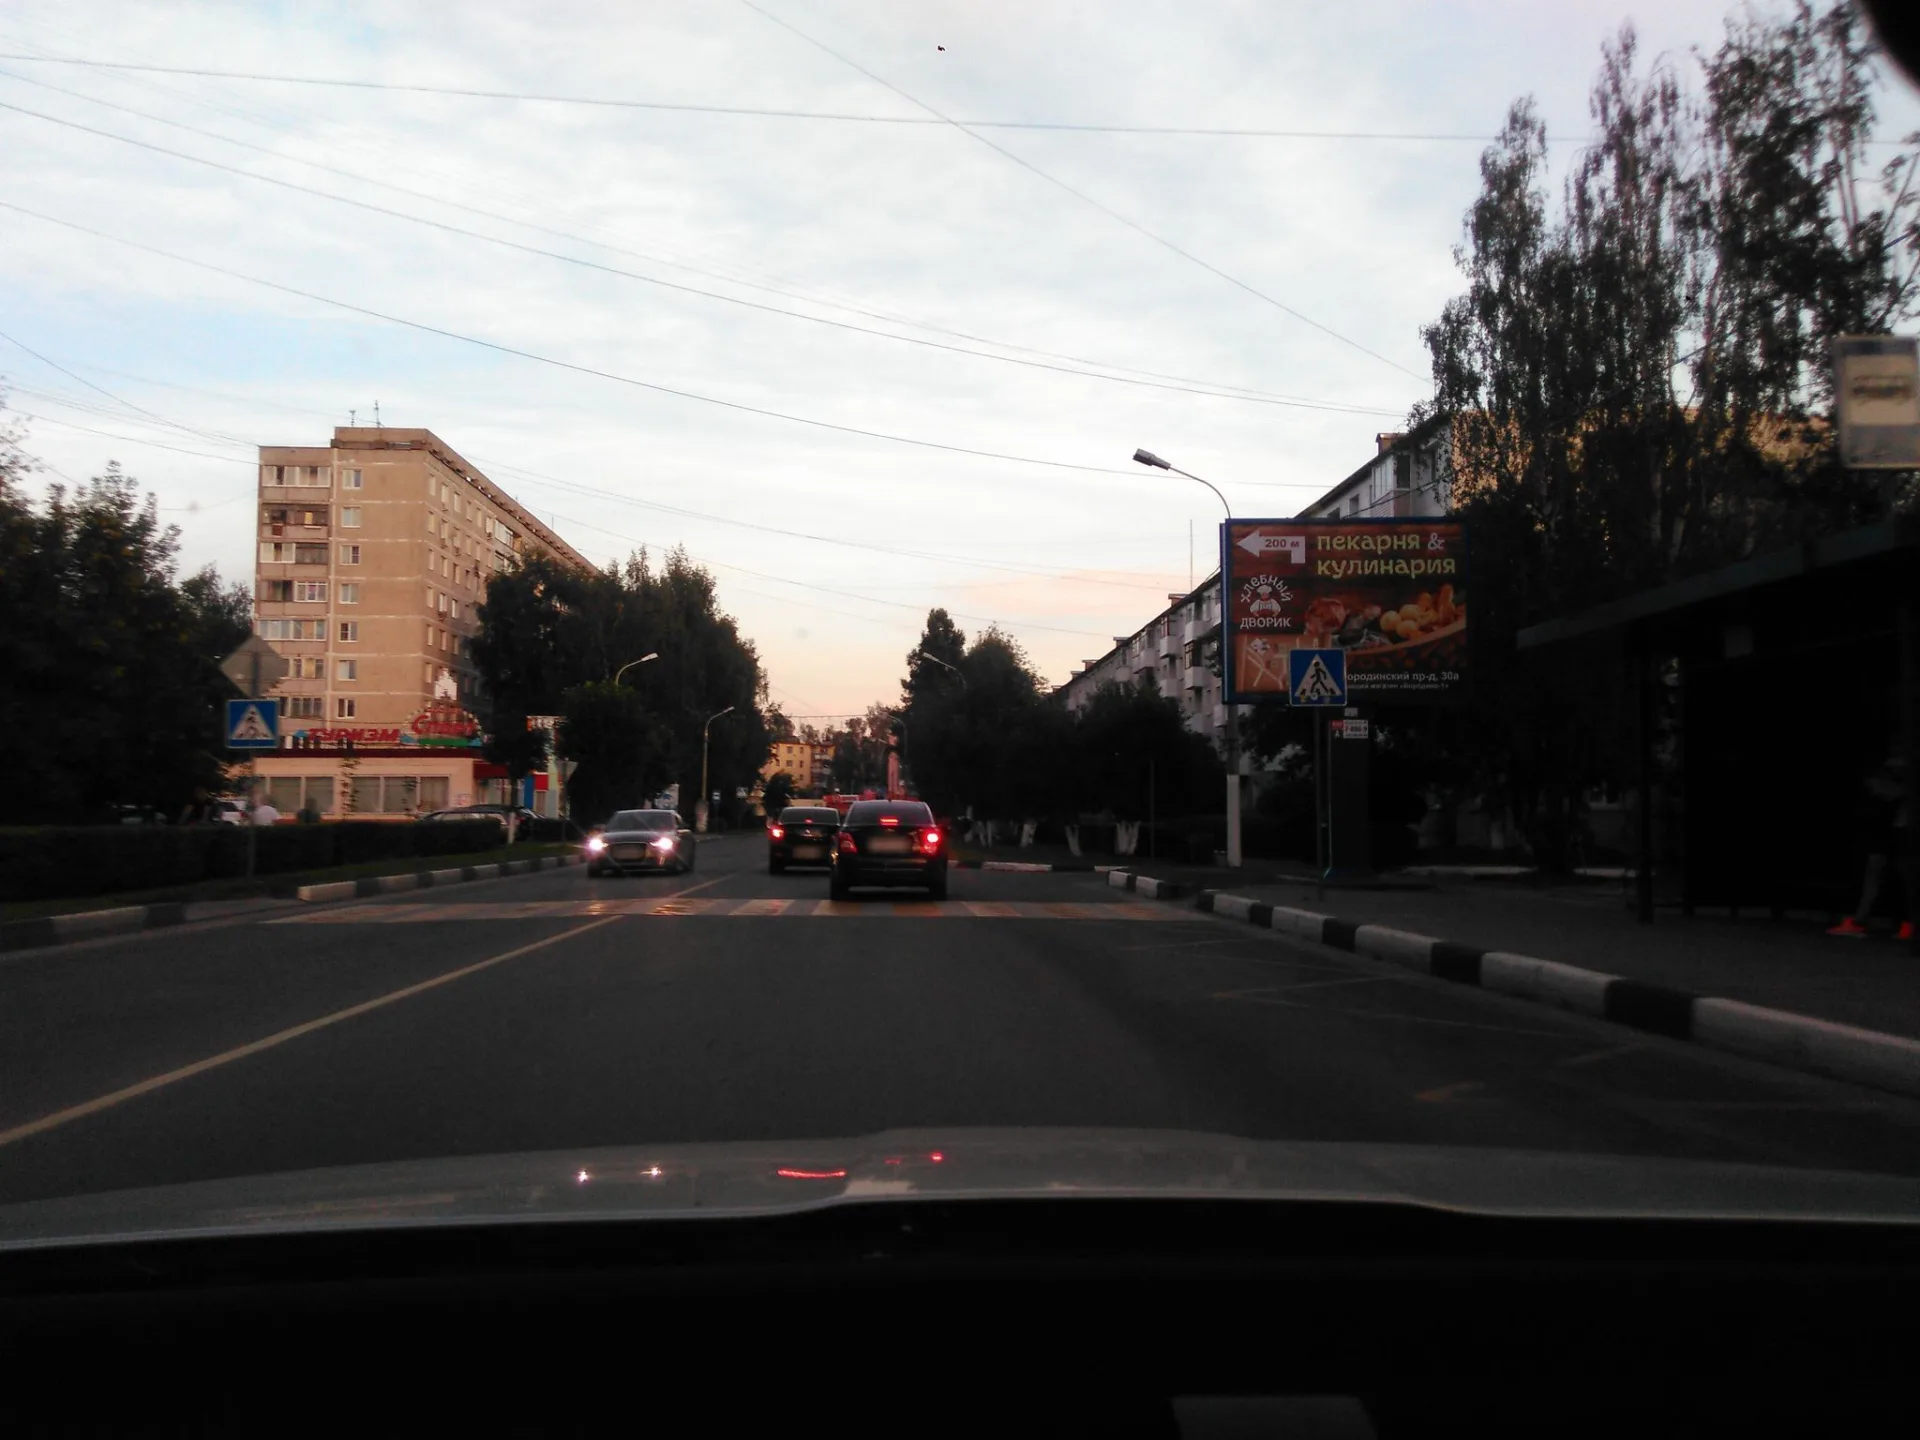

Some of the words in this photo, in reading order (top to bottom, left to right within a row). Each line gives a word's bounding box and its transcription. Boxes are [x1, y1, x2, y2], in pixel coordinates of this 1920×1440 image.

[1264, 538, 1287, 548] 200
[1316, 534, 1421, 555] пекарня
[1427, 532, 1445, 550] &
[1316, 557, 1456, 579] кулинария
[1239, 616, 1291, 630] ДВОРИК
[1347, 671, 1410, 683] ородинский
